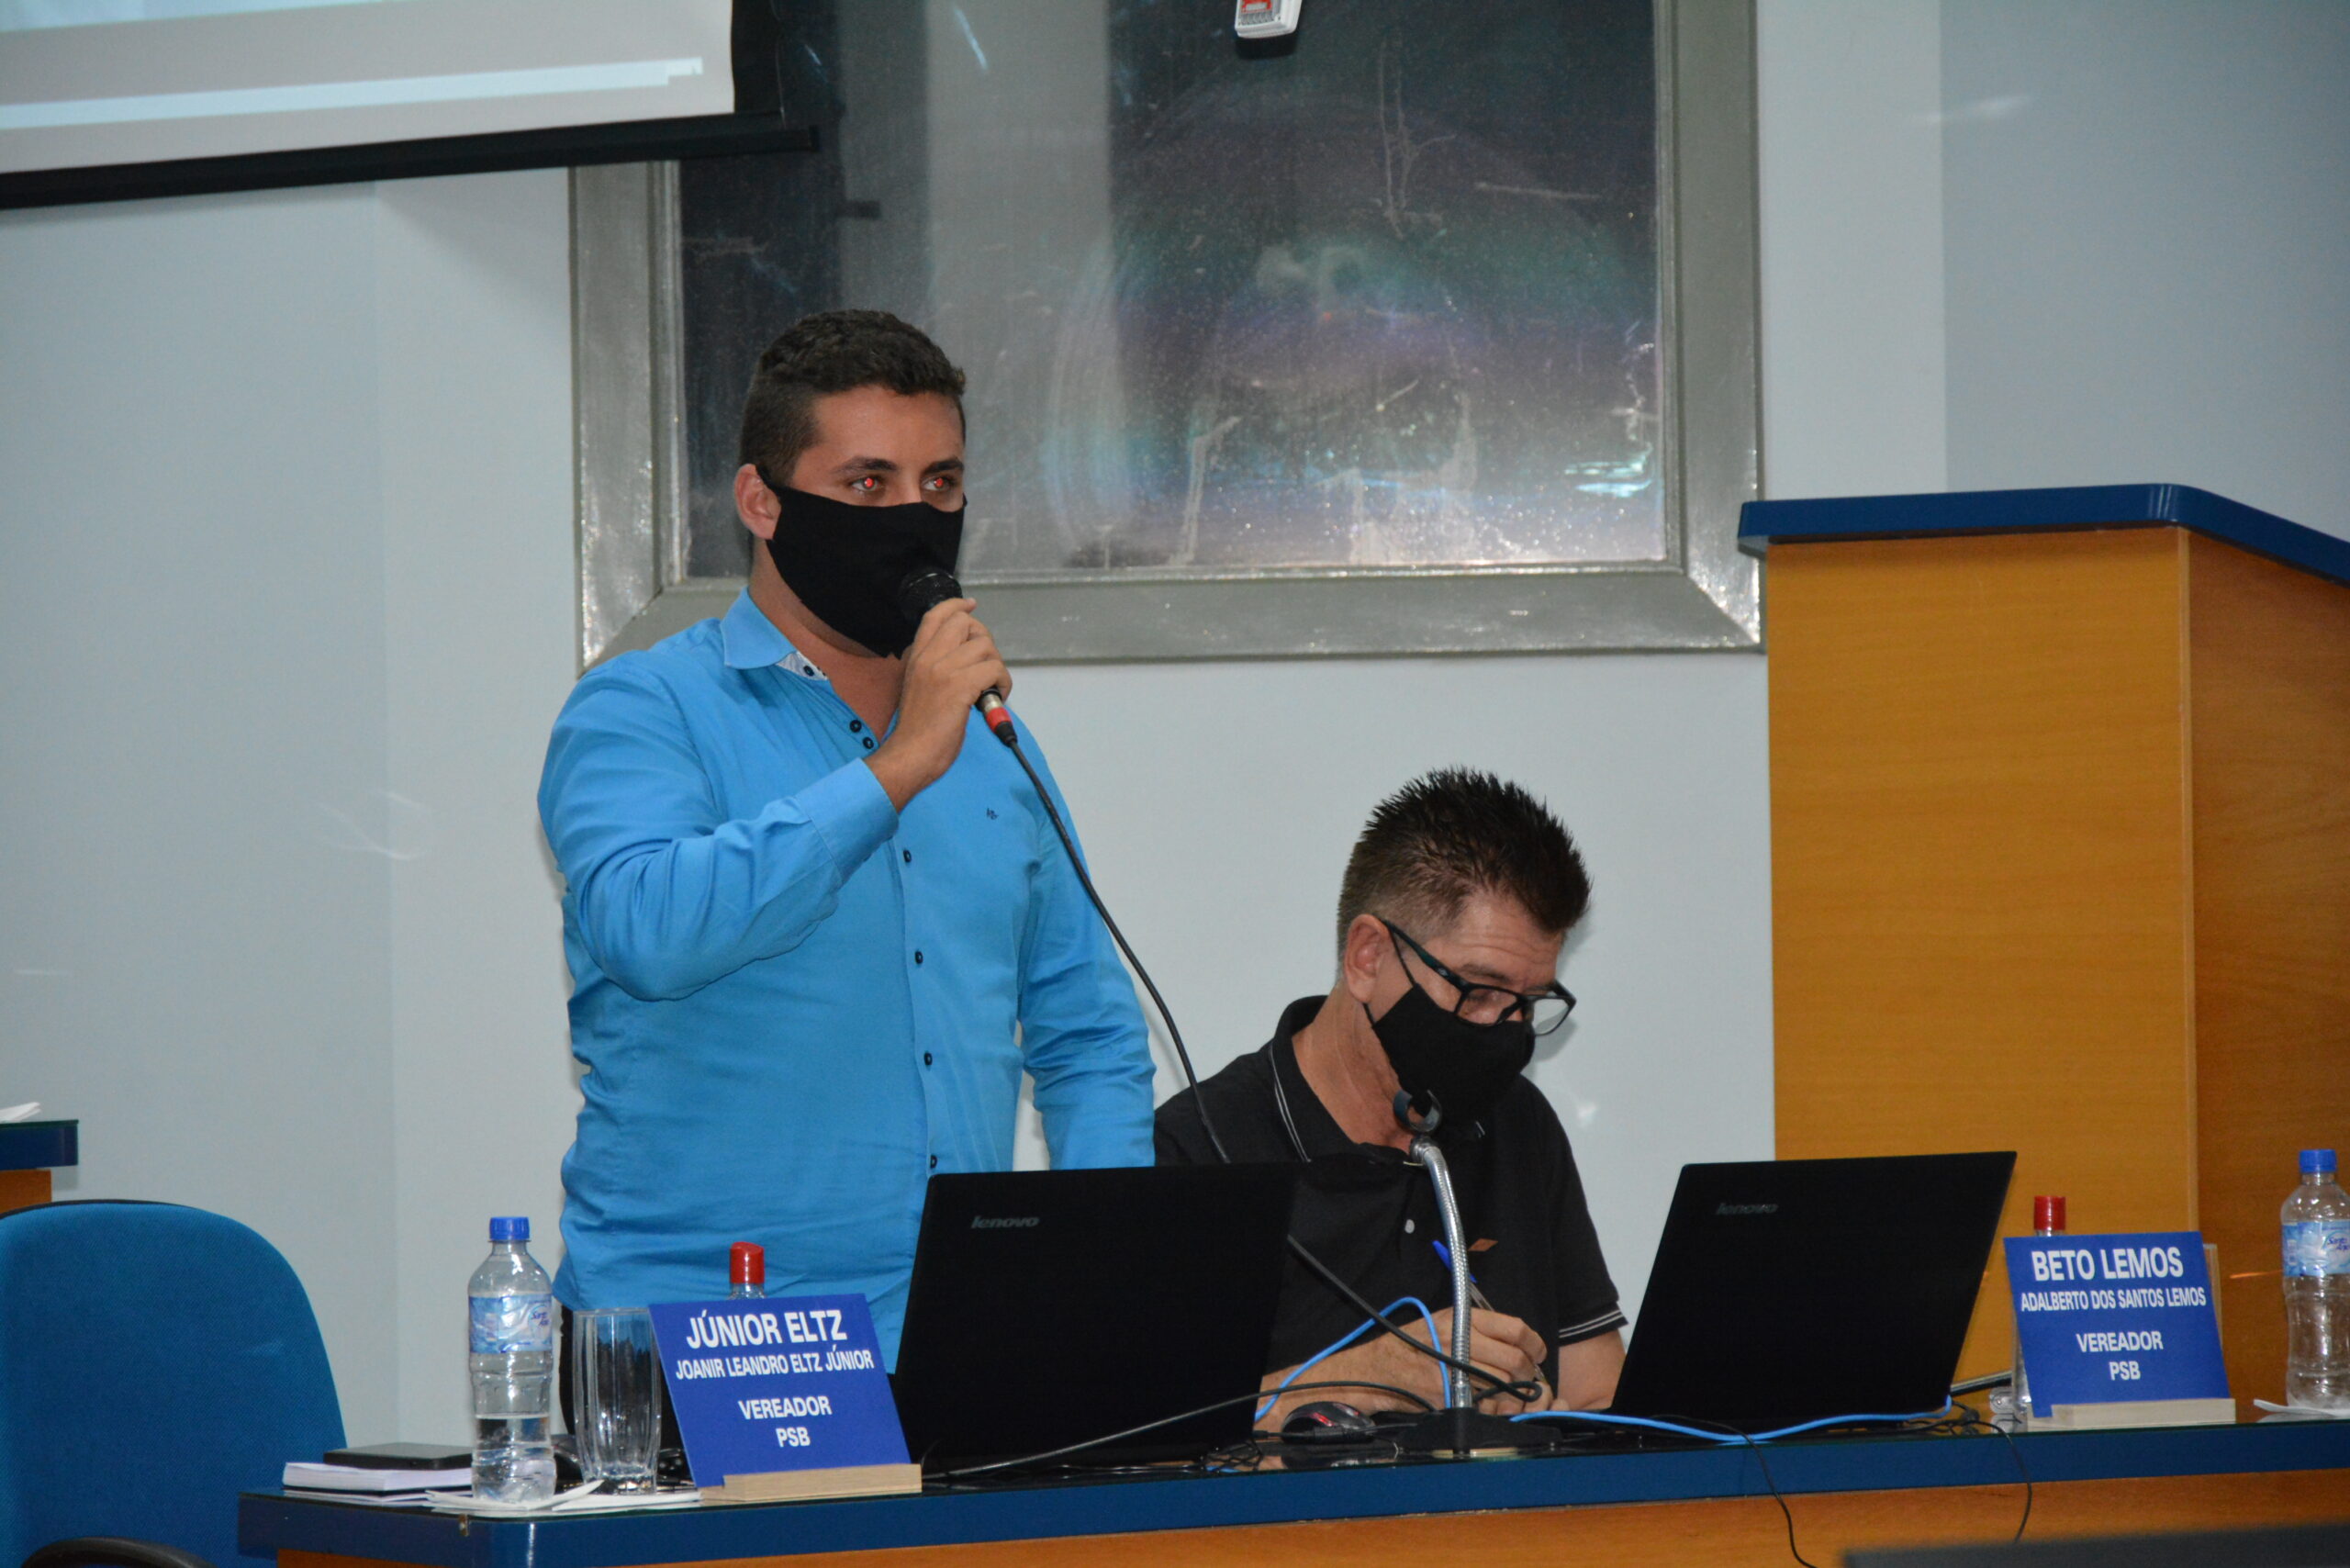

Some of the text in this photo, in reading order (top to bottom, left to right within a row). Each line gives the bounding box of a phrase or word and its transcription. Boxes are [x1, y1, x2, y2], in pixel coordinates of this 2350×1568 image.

[1715, 1203, 1779, 1215] lenovo
[971, 1215, 1040, 1229] lenovo
[2031, 1247, 2184, 1282] BETO LEMOS
[2020, 1286, 2207, 1312] ADALBERTO DOS SANTOS LEMOS
[686, 1309, 847, 1349] JÚNIOR ELTZ
[2076, 1331, 2164, 1353] VEREADOR
[676, 1344, 875, 1380] JOANIR LEANDRO ELTZ JÚNIOR
[2109, 1361, 2141, 1381] PSB
[738, 1395, 832, 1419] VEREADOR
[776, 1427, 811, 1448] PSB
